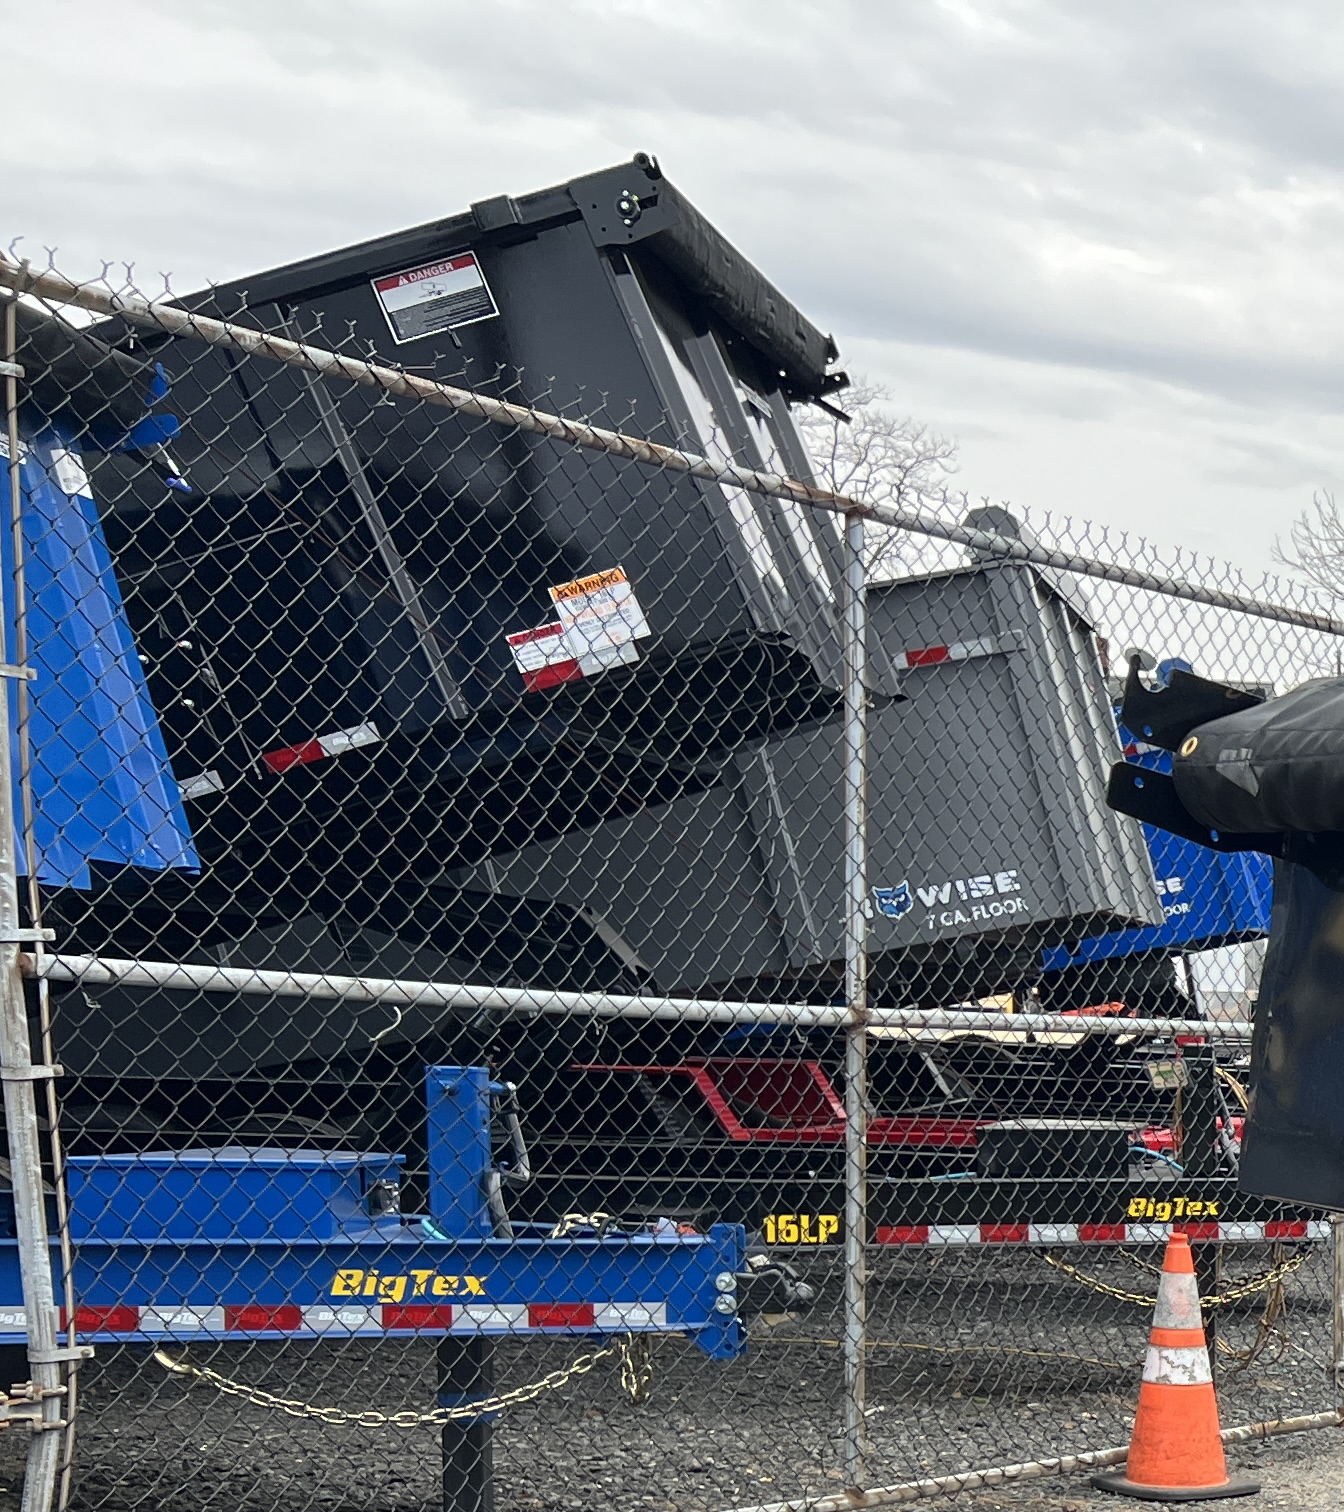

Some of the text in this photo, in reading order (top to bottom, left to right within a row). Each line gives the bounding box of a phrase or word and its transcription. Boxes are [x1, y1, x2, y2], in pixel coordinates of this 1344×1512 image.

[409, 262, 454, 283] DANGER
[917, 869, 1021, 908] WISE
[1127, 1197, 1219, 1221] BigTex
[763, 1214, 839, 1243] 16LP
[330, 1269, 488, 1303] BigTex
